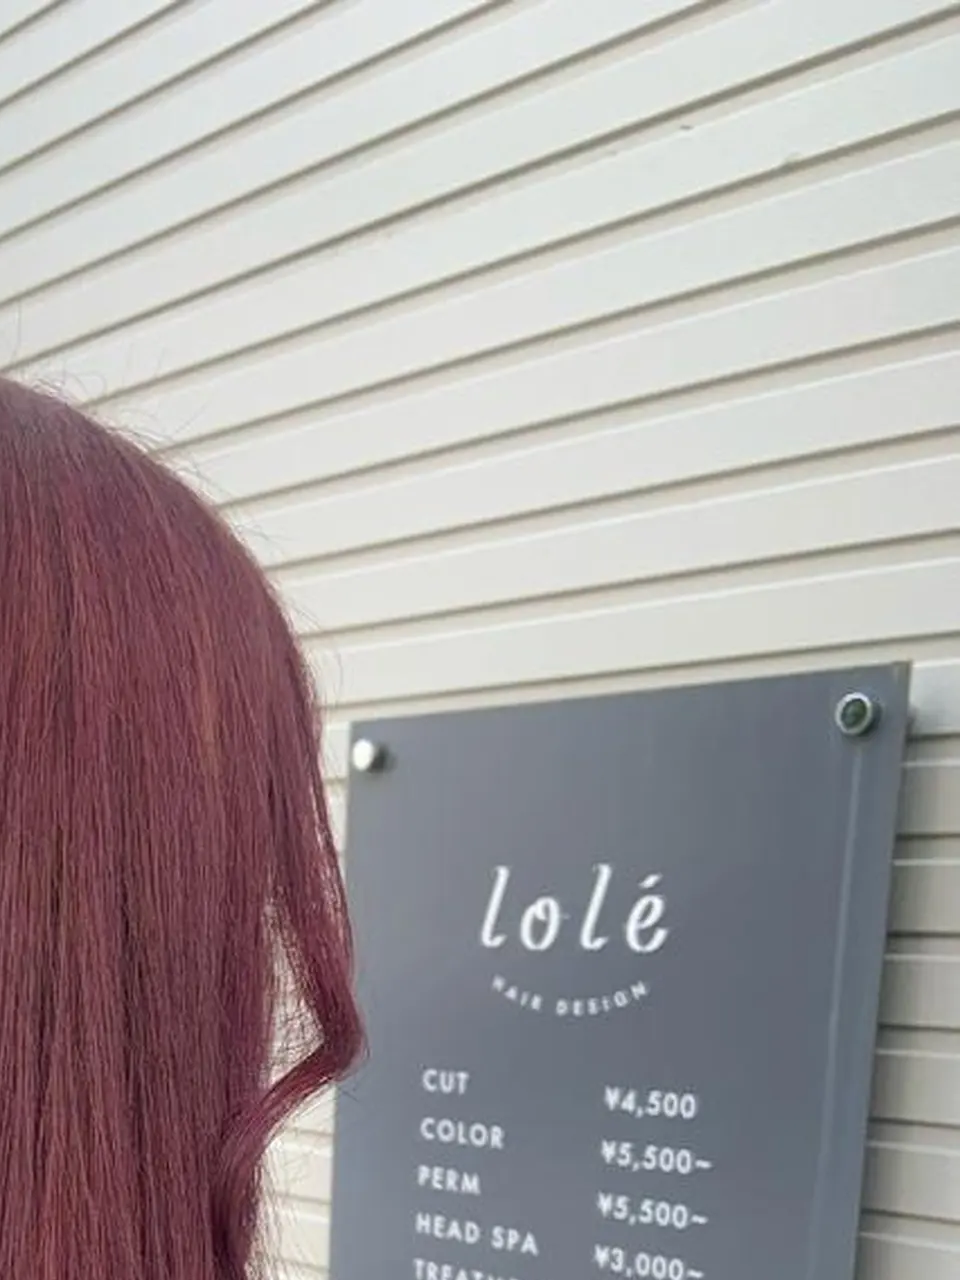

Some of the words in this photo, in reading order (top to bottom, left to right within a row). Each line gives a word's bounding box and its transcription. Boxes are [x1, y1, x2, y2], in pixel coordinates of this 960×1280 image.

[480, 863, 670, 954] lolé
[555, 980, 649, 1017] DESIGN
[422, 1068, 470, 1096] CUT
[603, 1086, 698, 1120] ¥4,500
[419, 1117, 505, 1150] COLOR
[417, 1164, 481, 1195] PERM
[415, 1212, 481, 1245] HEAD
[490, 1225, 539, 1257] SPA
